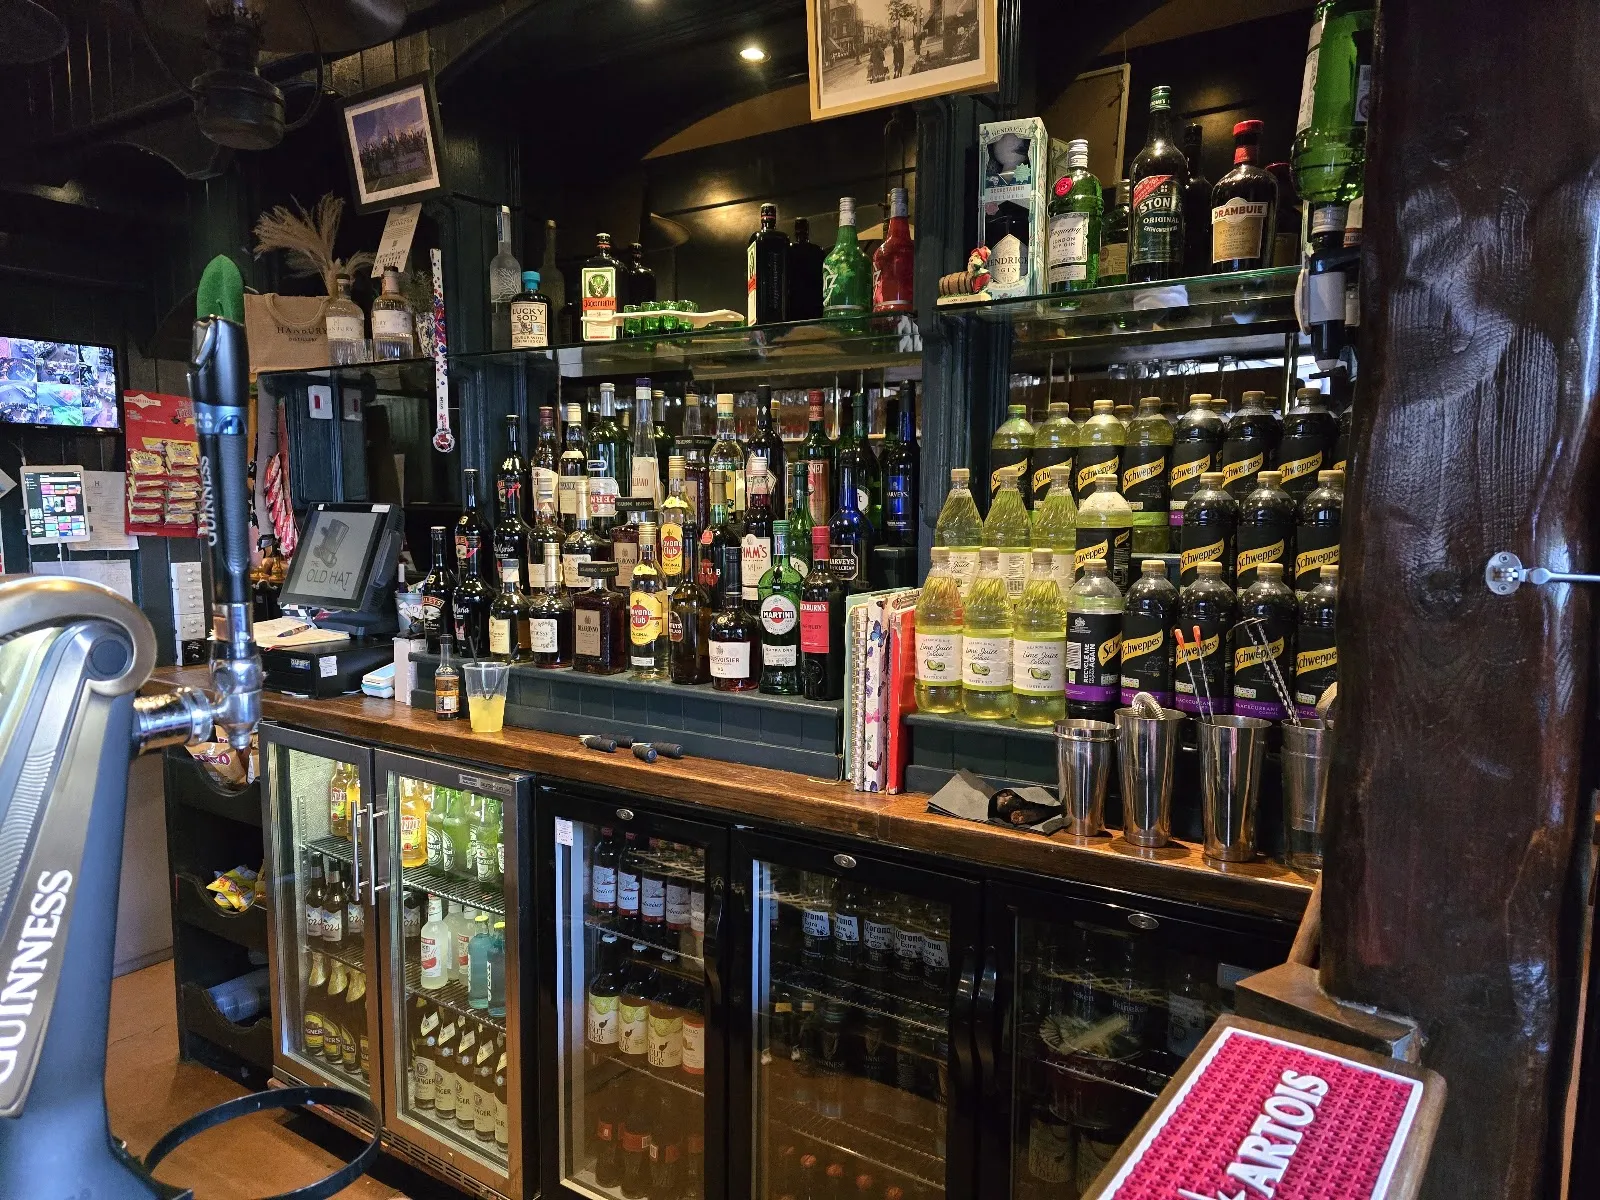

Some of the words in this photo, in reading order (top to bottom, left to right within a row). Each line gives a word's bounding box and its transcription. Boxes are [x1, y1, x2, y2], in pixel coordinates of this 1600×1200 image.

[1214, 205, 1263, 220] DRAMBUIE
[516, 314, 538, 322] SOD
[277, 327, 328, 335] HANBURY
[1079, 461, 1118, 485] Schweppes
[1124, 462, 1164, 486] Schweppes
[1171, 461, 1209, 483] Schweppes
[1222, 457, 1262, 481] Schweppes
[200, 456, 218, 546] GUINNESS
[1180, 547, 1222, 570] Schweppes
[1238, 546, 1281, 570] Schweppes
[306, 568, 326, 584] OLD
[329, 572, 352, 592] HAT
[935, 643, 952, 656] Juice
[978, 648, 998, 658] Juice
[1022, 651, 1038, 659] Lime
[1039, 652, 1058, 662] Juice
[864, 922, 892, 934] Corona
[870, 932, 885, 941] Extra
[1226, 1070, 1330, 1200] ARTOIS
